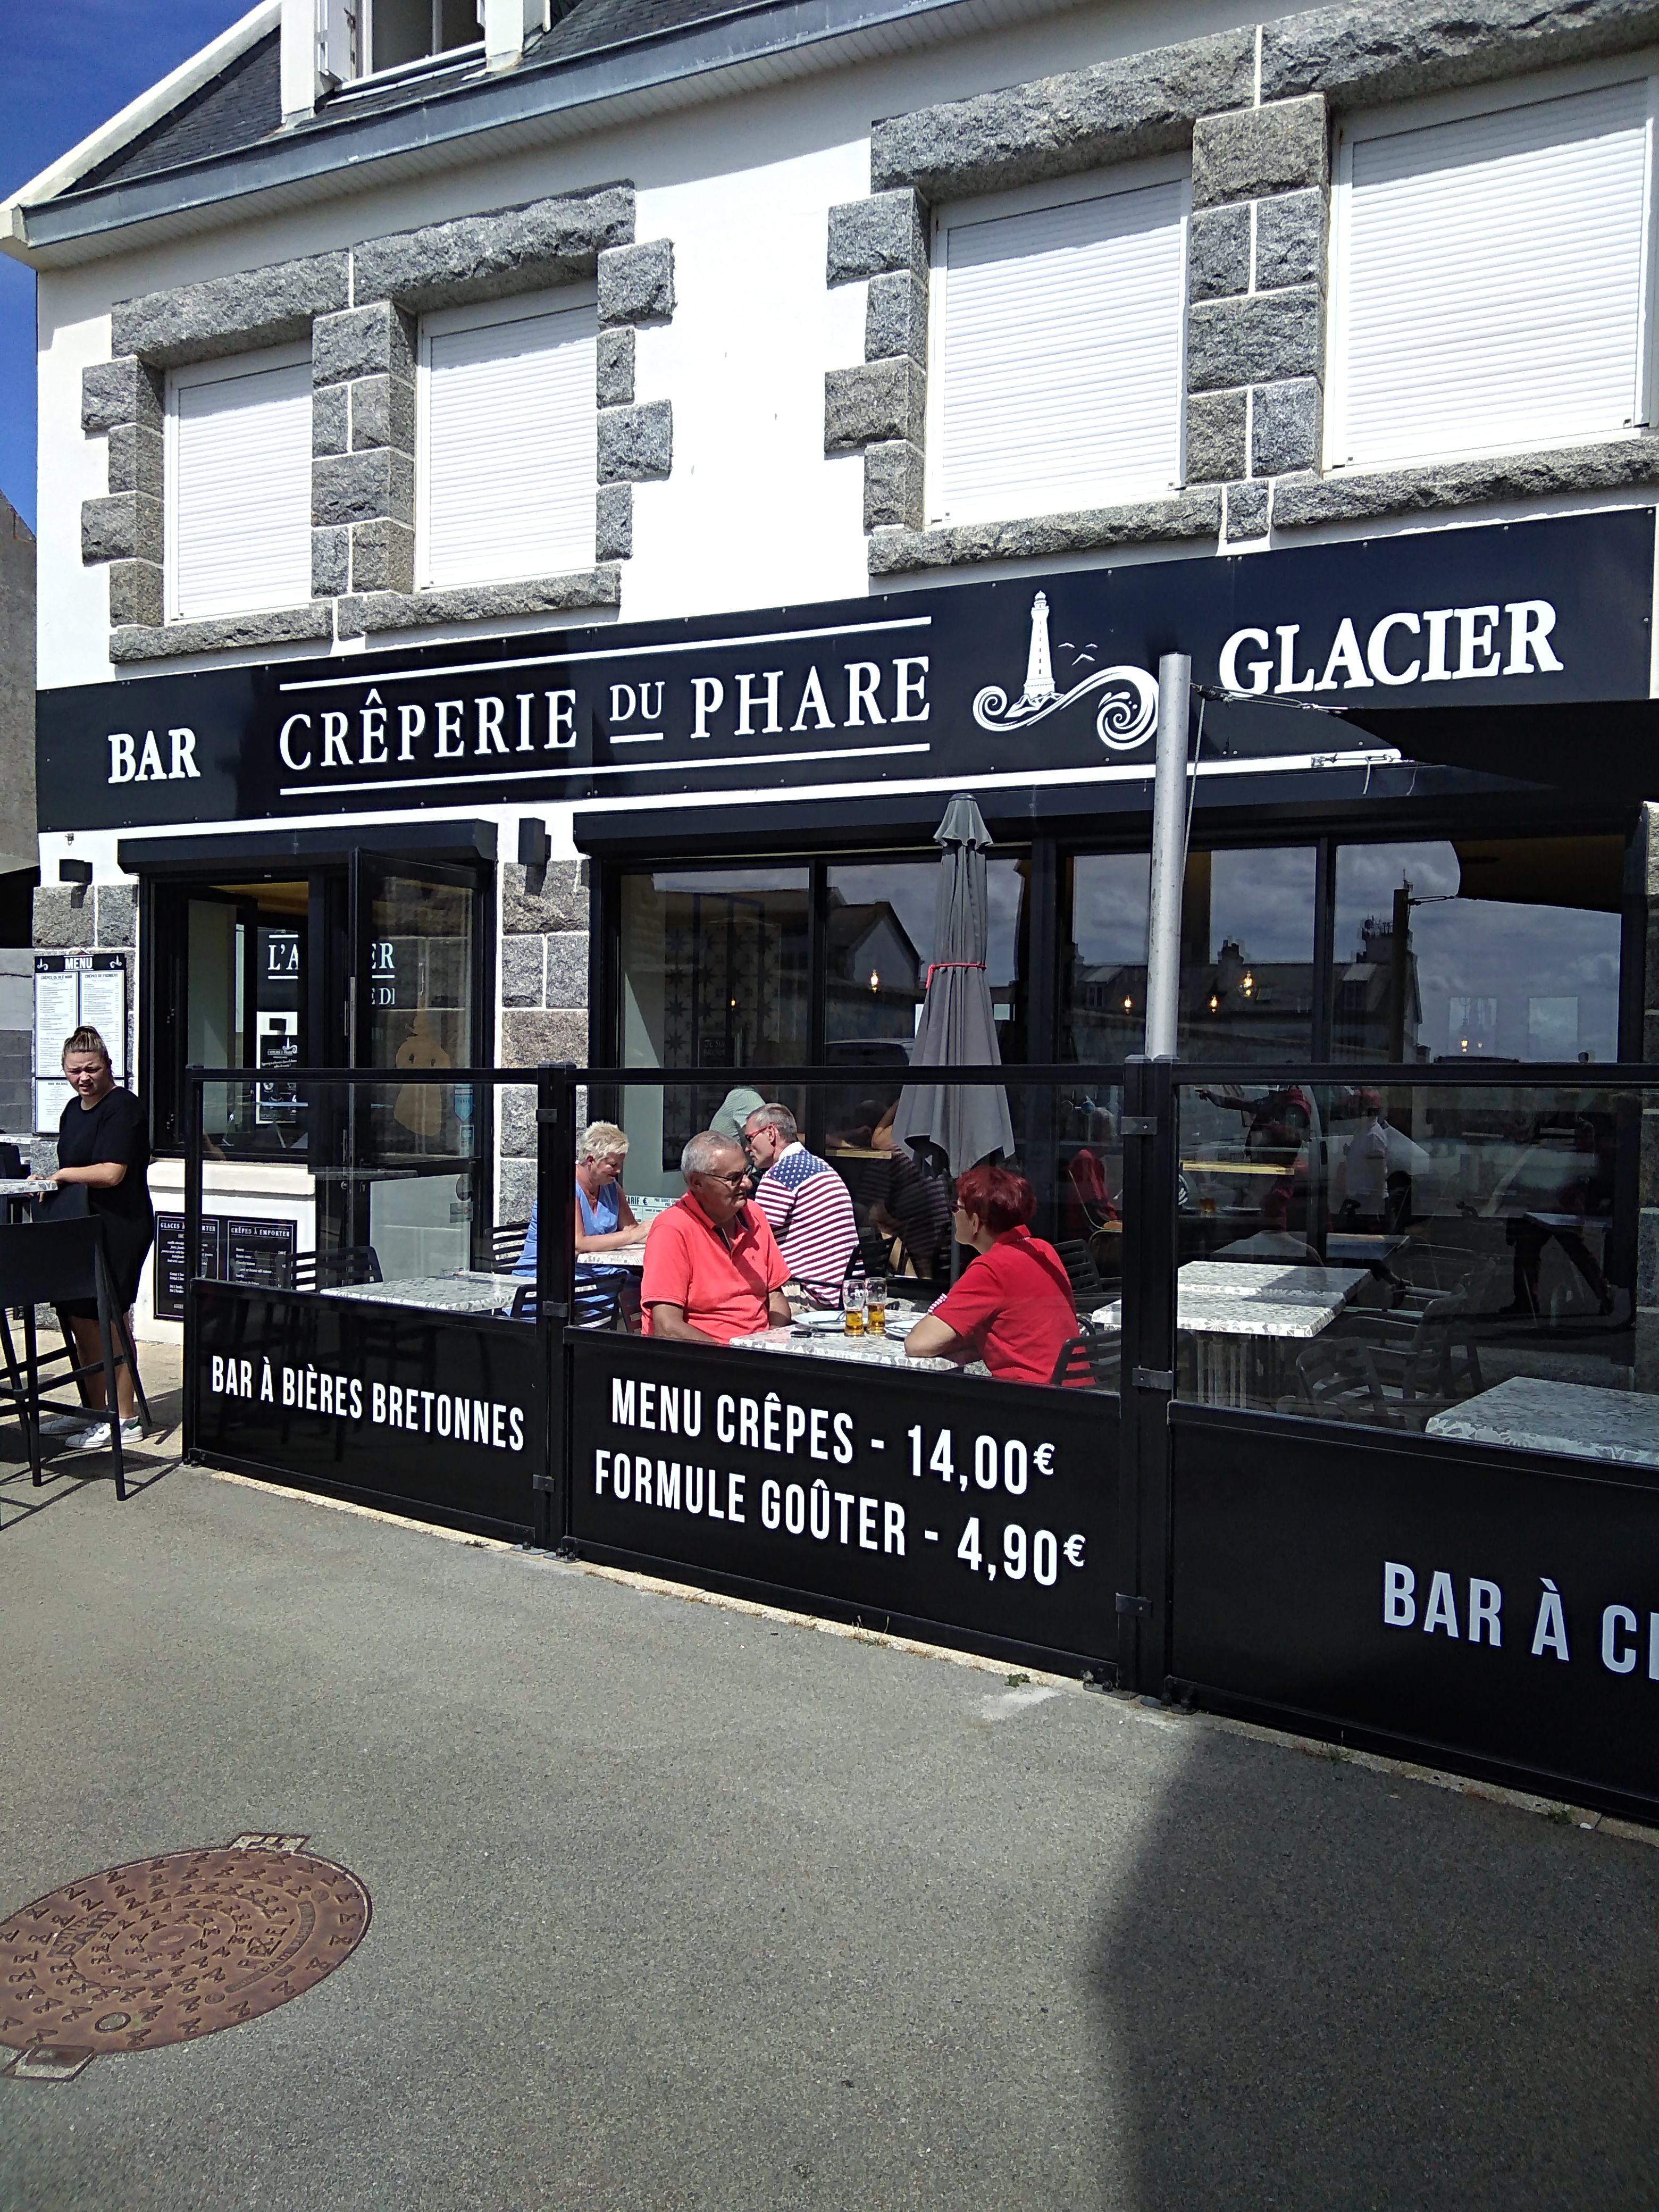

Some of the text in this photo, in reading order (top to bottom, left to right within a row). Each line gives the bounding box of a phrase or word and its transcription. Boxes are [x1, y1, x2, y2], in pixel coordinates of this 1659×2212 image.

[1214, 600, 1563, 696] GLACIER
[108, 728, 200, 783] BAR
[280, 656, 929, 770] CRÊPERIE DU PHARE
[65, 958, 93, 969] MENU
[212, 1355, 524, 1451] BAR À BIÈRES BRETONNES
[612, 1378, 701, 1437] MENU
[717, 1392, 852, 1464] CRÊPES
[908, 1425, 1054, 1495] 14,00€
[596, 1449, 745, 1523] FORMULE
[761, 1478, 905, 1556] GOÛTER
[958, 1516, 1086, 1586] 4,90€
[1384, 1561, 1502, 1647] BAR
[1531, 1577, 1570, 1662] À
